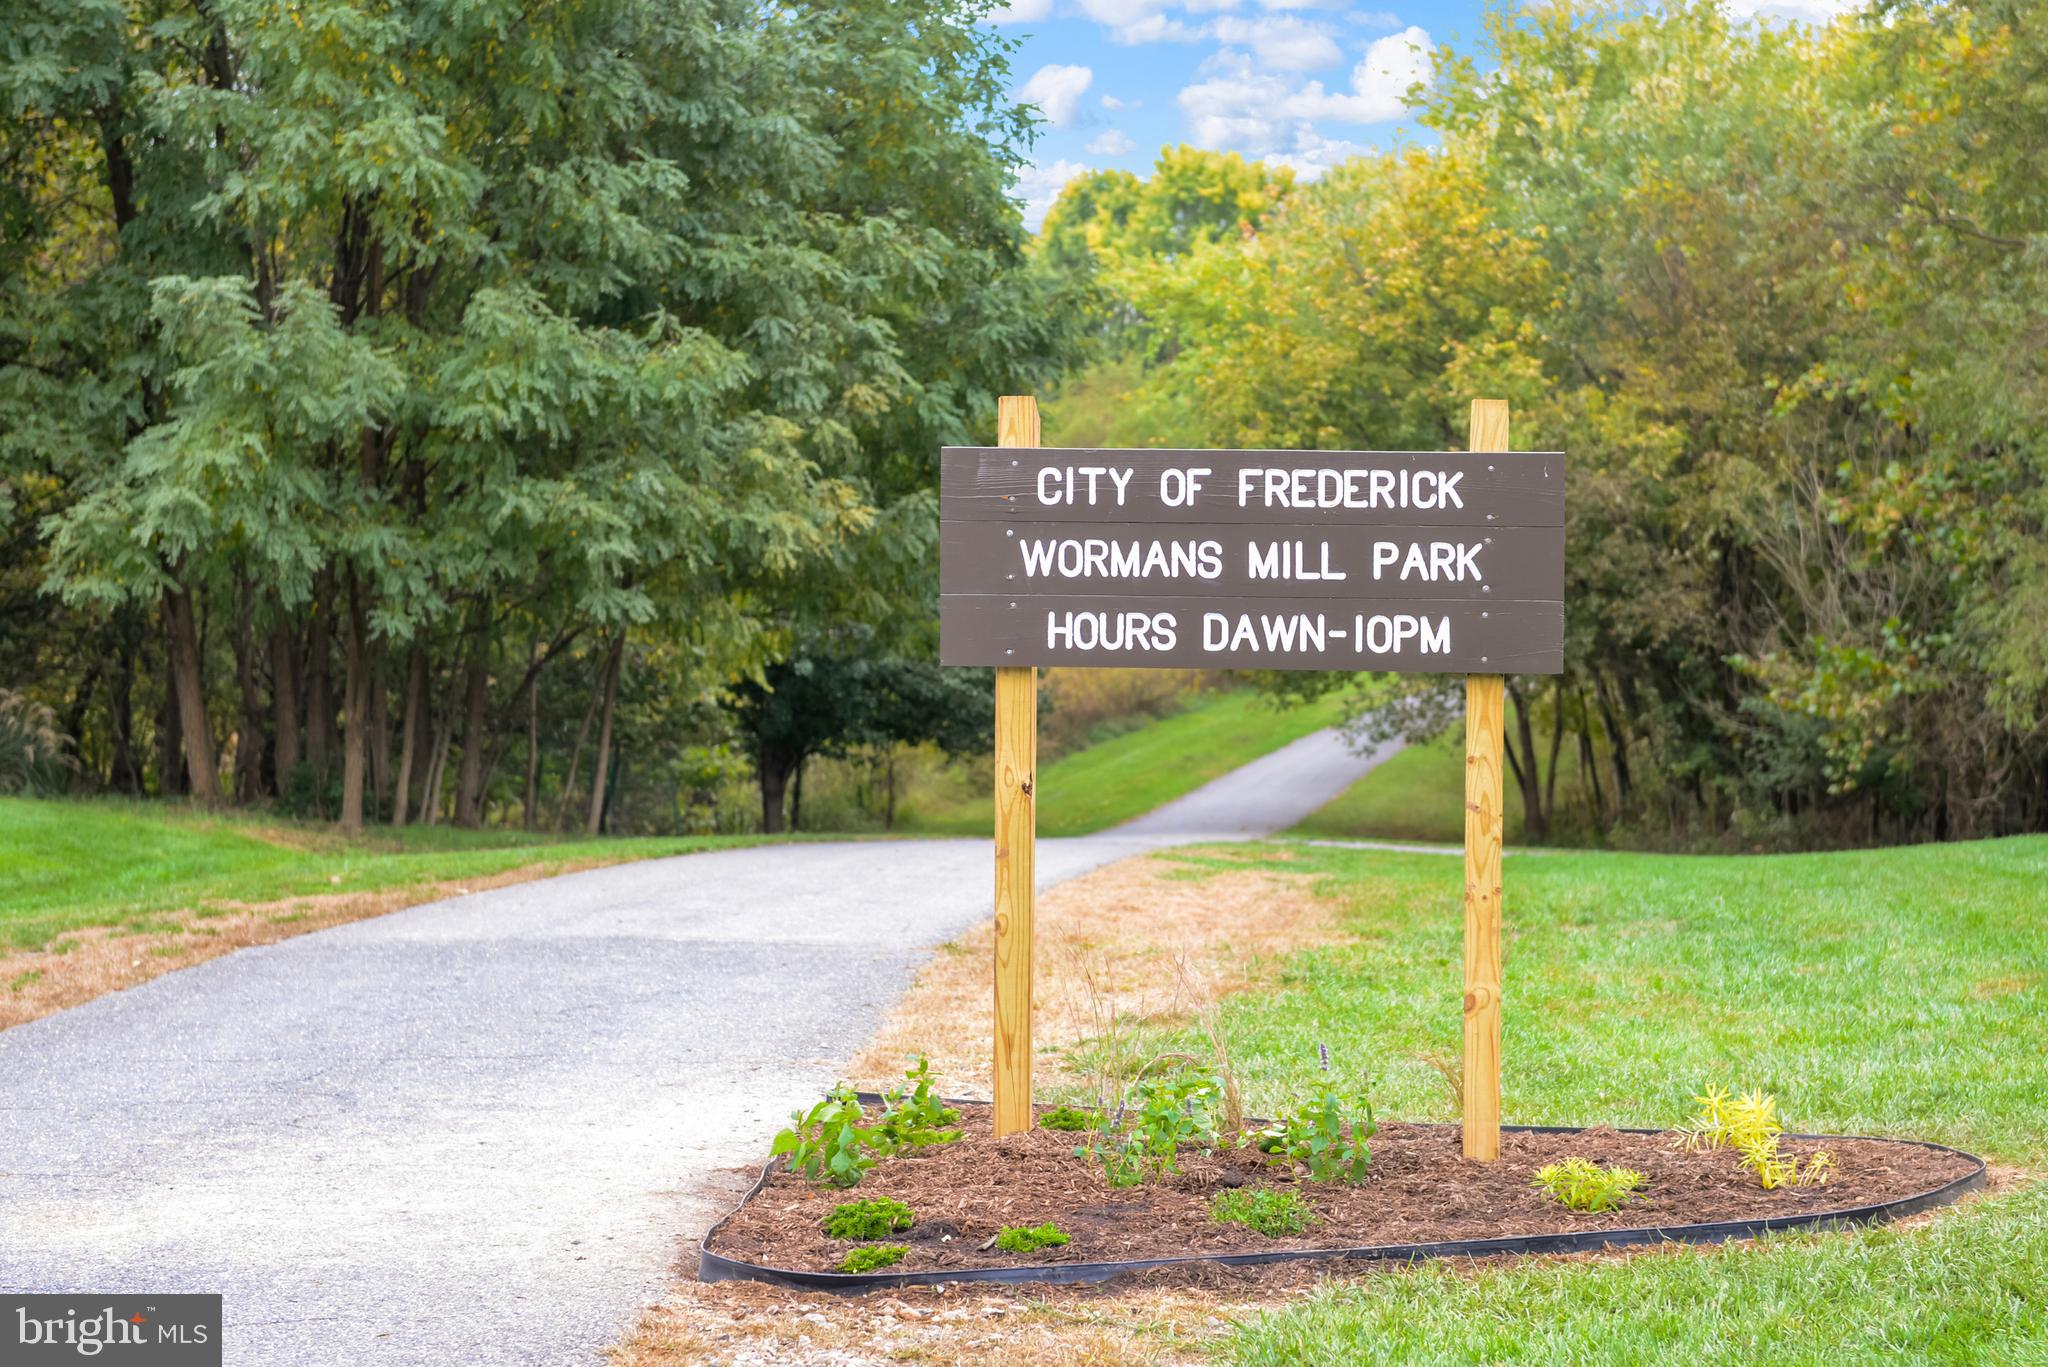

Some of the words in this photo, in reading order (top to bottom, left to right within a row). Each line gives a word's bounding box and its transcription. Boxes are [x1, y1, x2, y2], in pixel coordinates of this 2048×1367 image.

[1037, 467, 1134, 505] CITY
[1160, 468, 1212, 506] OF
[1239, 468, 1463, 509] FREDERICK
[1020, 539, 1222, 579] WORMANS
[1249, 541, 1346, 580] MILL
[1373, 542, 1482, 581] PARK
[1048, 611, 1177, 651] HOURS
[1203, 613, 1451, 654] DAWN-10PM
